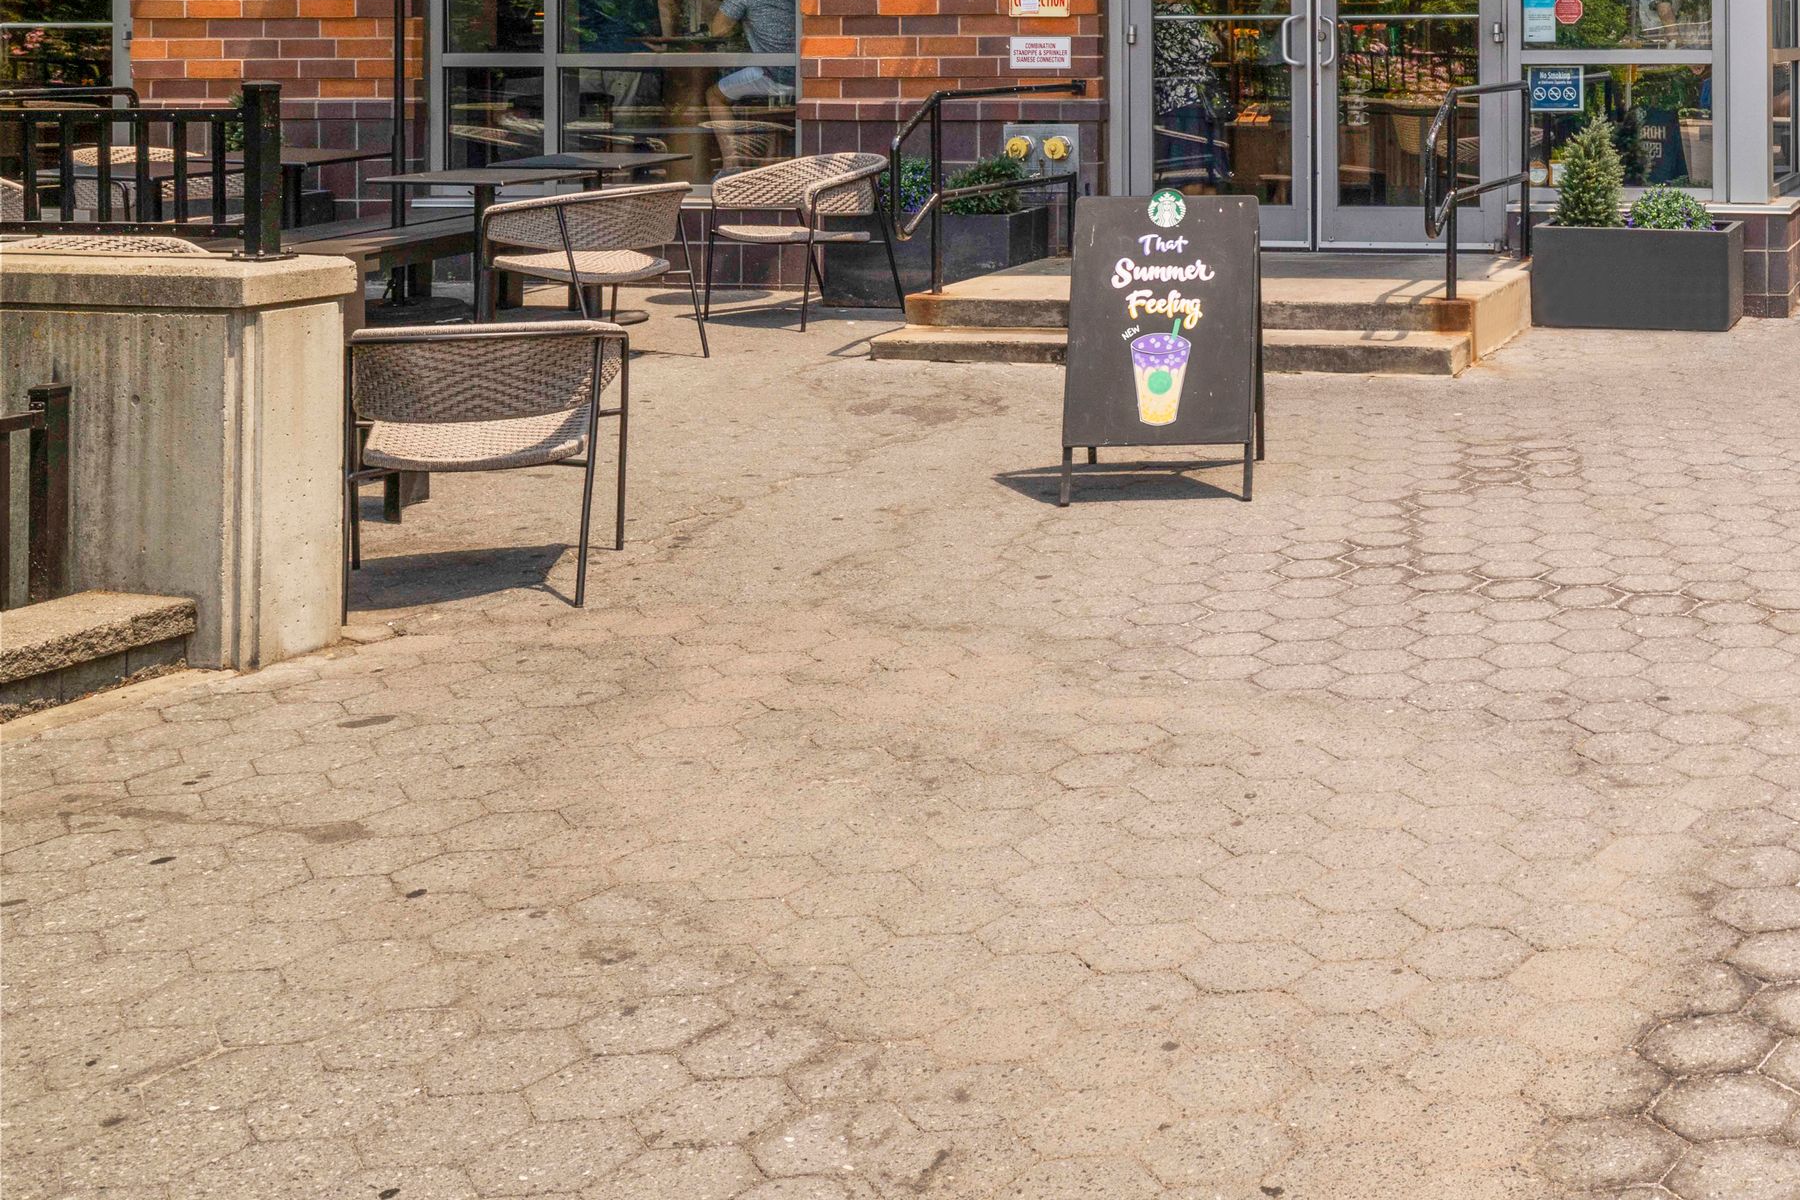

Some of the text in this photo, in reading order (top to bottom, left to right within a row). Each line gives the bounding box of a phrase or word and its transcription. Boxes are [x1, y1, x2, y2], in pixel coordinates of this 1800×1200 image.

[1548, 72, 1571, 80] Smoking
[1138, 234, 1189, 256] That
[1111, 258, 1215, 289] Summer
[1125, 289, 1203, 330] Feeling
[1121, 325, 1141, 341] NEW
